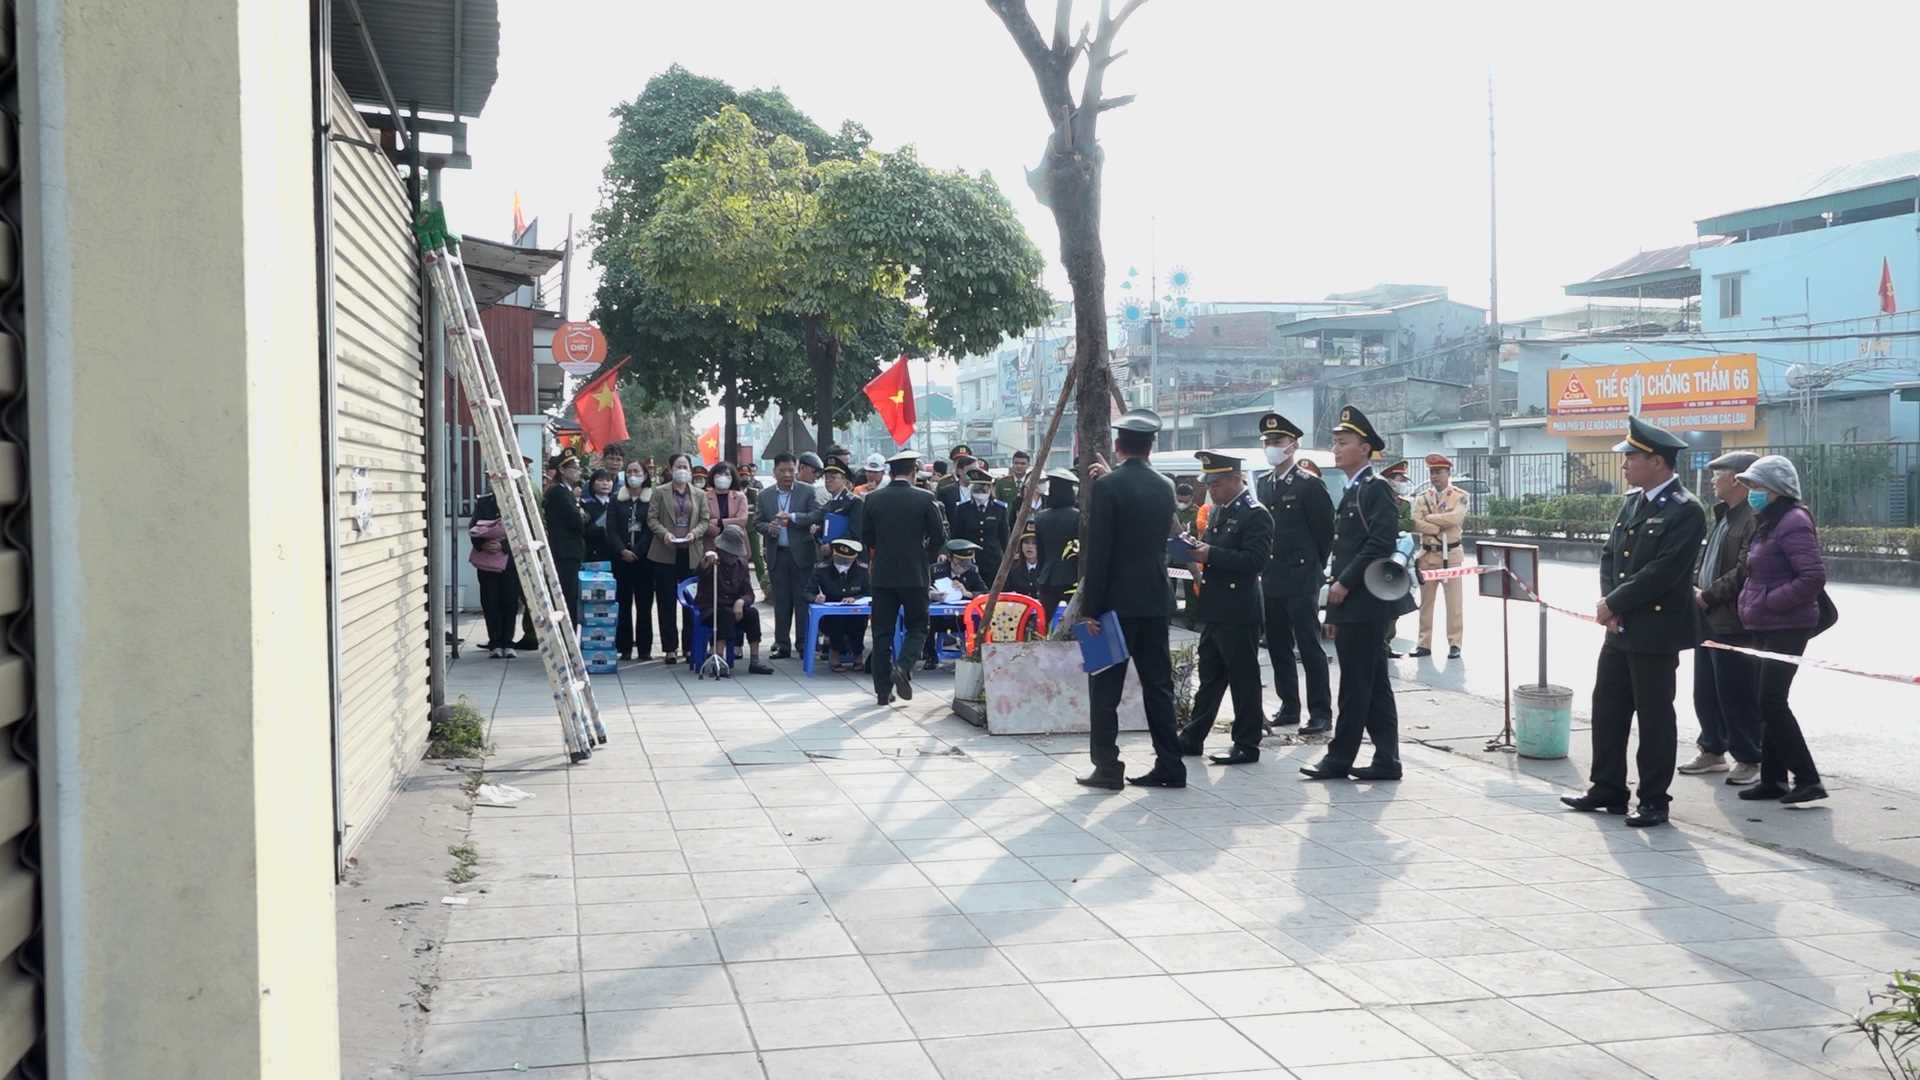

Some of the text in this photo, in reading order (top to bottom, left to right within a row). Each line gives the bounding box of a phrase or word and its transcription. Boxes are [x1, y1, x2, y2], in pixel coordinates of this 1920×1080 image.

[1596, 368, 1618, 399] THẾ
[1648, 362, 1690, 395] CHỐNG
[1694, 359, 1729, 392] THẤM
[1734, 368, 1749, 390] 66
